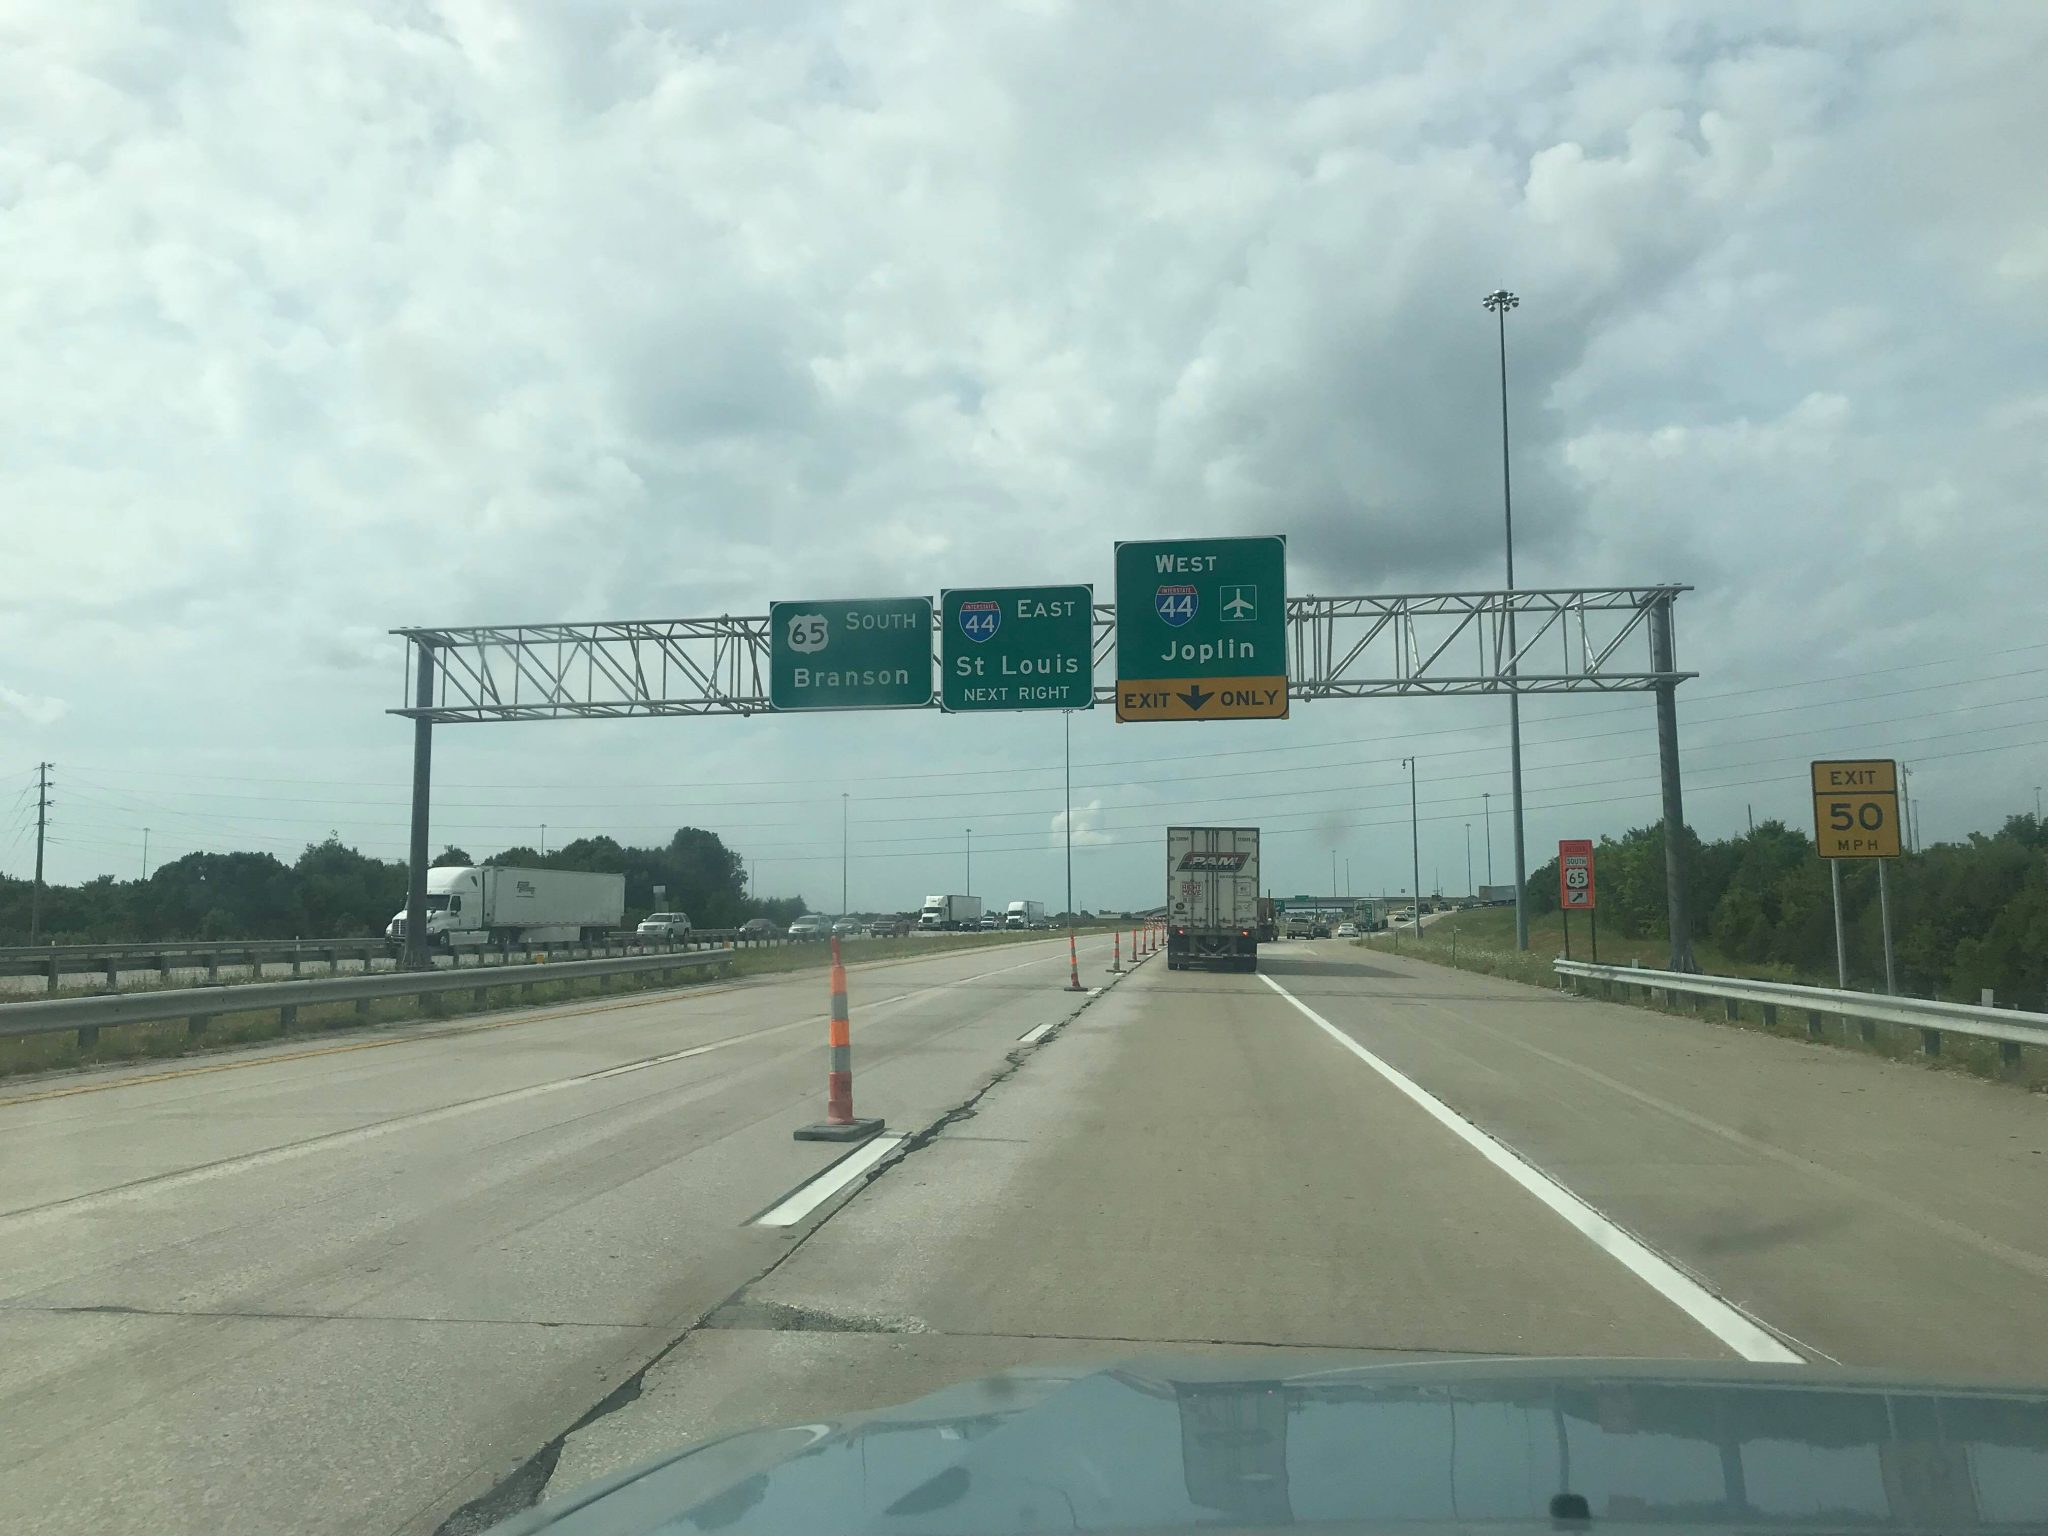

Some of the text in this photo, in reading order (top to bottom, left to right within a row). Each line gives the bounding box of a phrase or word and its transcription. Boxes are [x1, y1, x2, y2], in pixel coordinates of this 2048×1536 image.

[1155, 554, 1217, 573] WEST
[1018, 599, 1076, 618] EAST
[1159, 595, 1193, 618] 44
[845, 611, 917, 632] SOUTH
[965, 614, 995, 633] 44
[791, 622, 826, 644] 65
[1161, 639, 1254, 664] Joplin
[956, 653, 1078, 676] St Louis
[794, 666, 909, 688] Branson
[964, 685, 1070, 701] NEXT RIGHT
[1124, 689, 1279, 709] EXIT ONLY
[1830, 770, 1876, 785] EXIT
[1830, 802, 1883, 831] 50
[1837, 839, 1879, 851] MPH
[1570, 873, 1584, 884] 65
